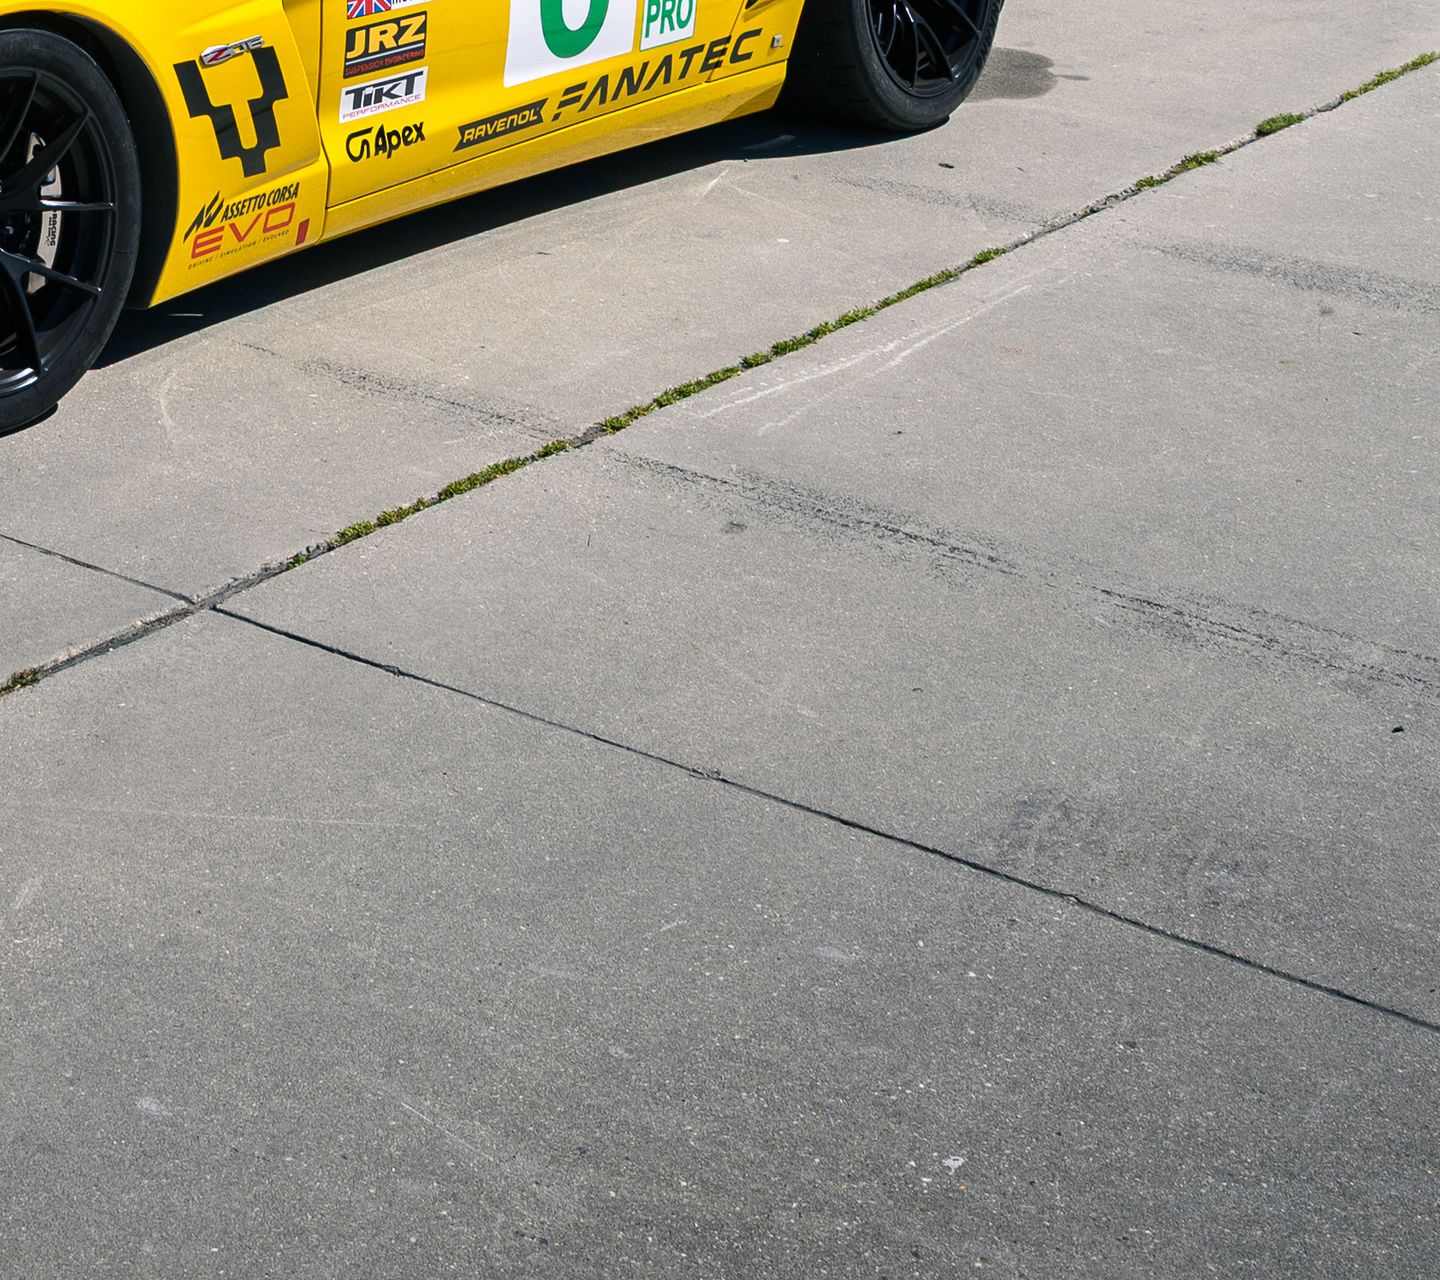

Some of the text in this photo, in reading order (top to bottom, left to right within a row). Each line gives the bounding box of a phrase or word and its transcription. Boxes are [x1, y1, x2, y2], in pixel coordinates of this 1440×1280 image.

[347, 14, 426, 59] JRZ
[551, 28, 763, 122] FANATEC
[342, 94, 421, 120] PERFORMANCE
[463, 108, 538, 143] RAVENOL
[374, 122, 426, 159] Apex
[221, 182, 300, 223] ASSETTO CORSA
[191, 202, 296, 259] EVO
